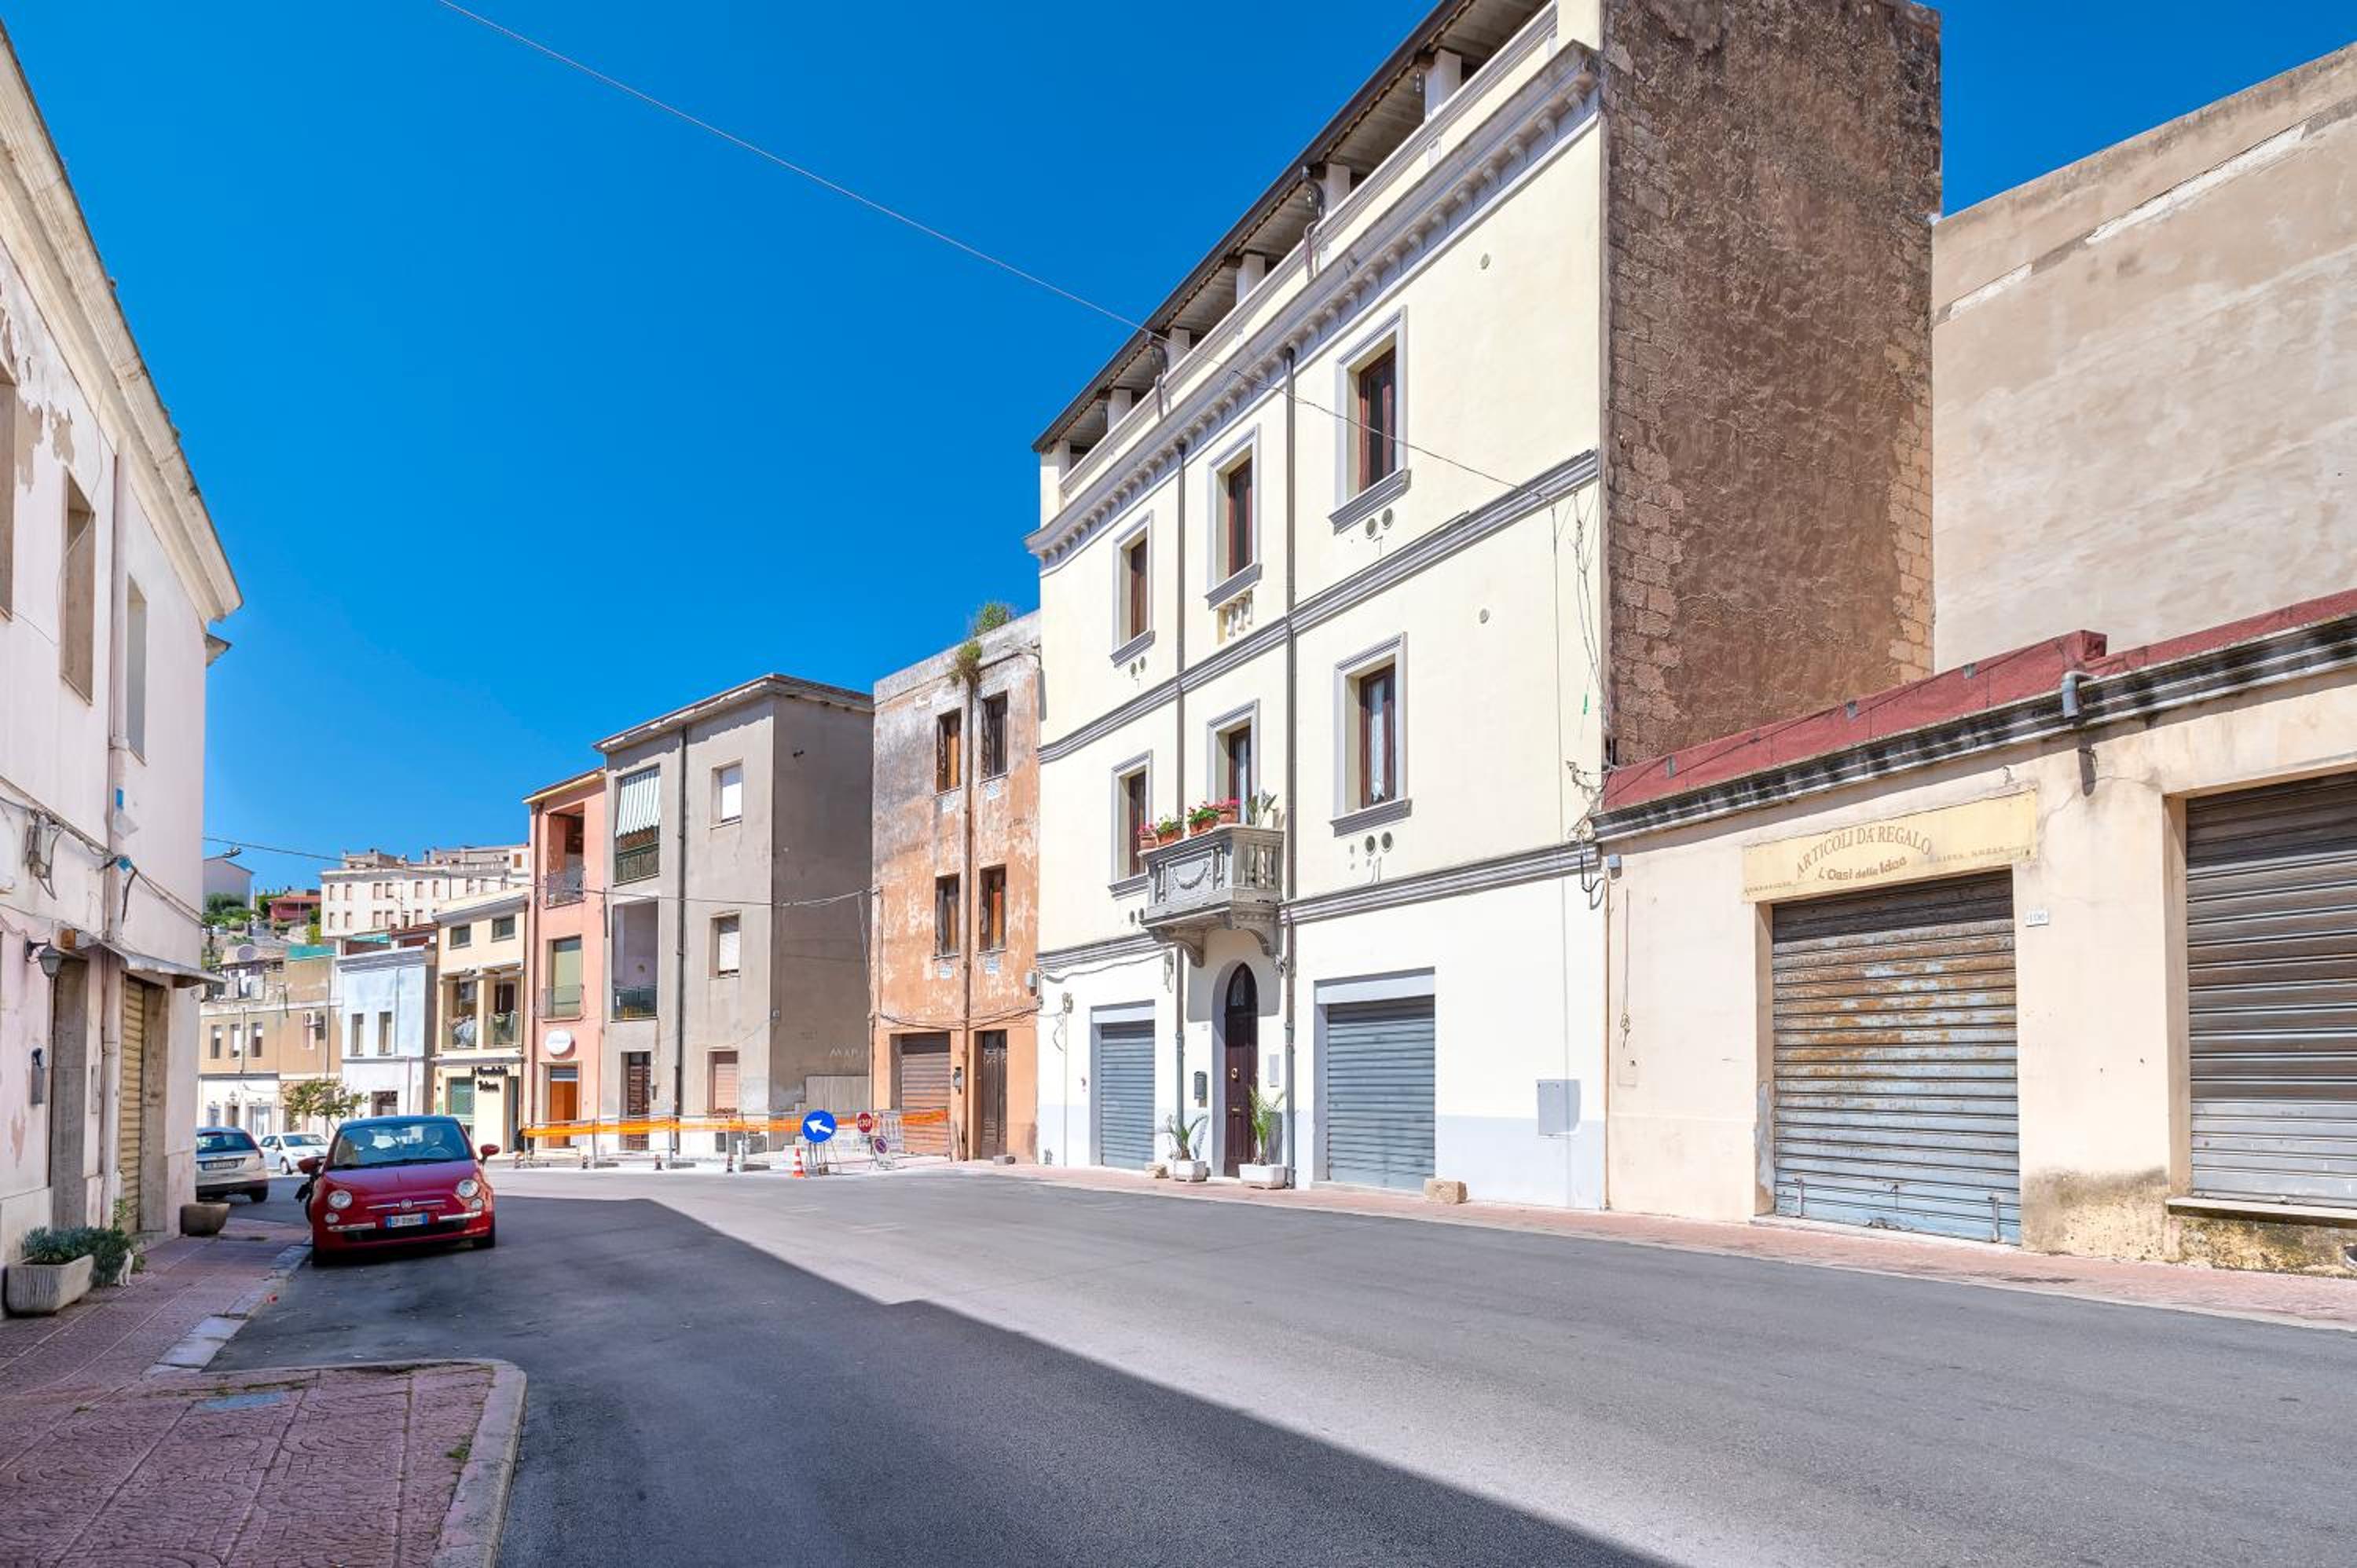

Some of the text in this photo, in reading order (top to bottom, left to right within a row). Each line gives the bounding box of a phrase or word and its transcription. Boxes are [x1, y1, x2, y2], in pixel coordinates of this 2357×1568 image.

[1796, 826, 1932, 874] ARTICOLI DA REGALO
